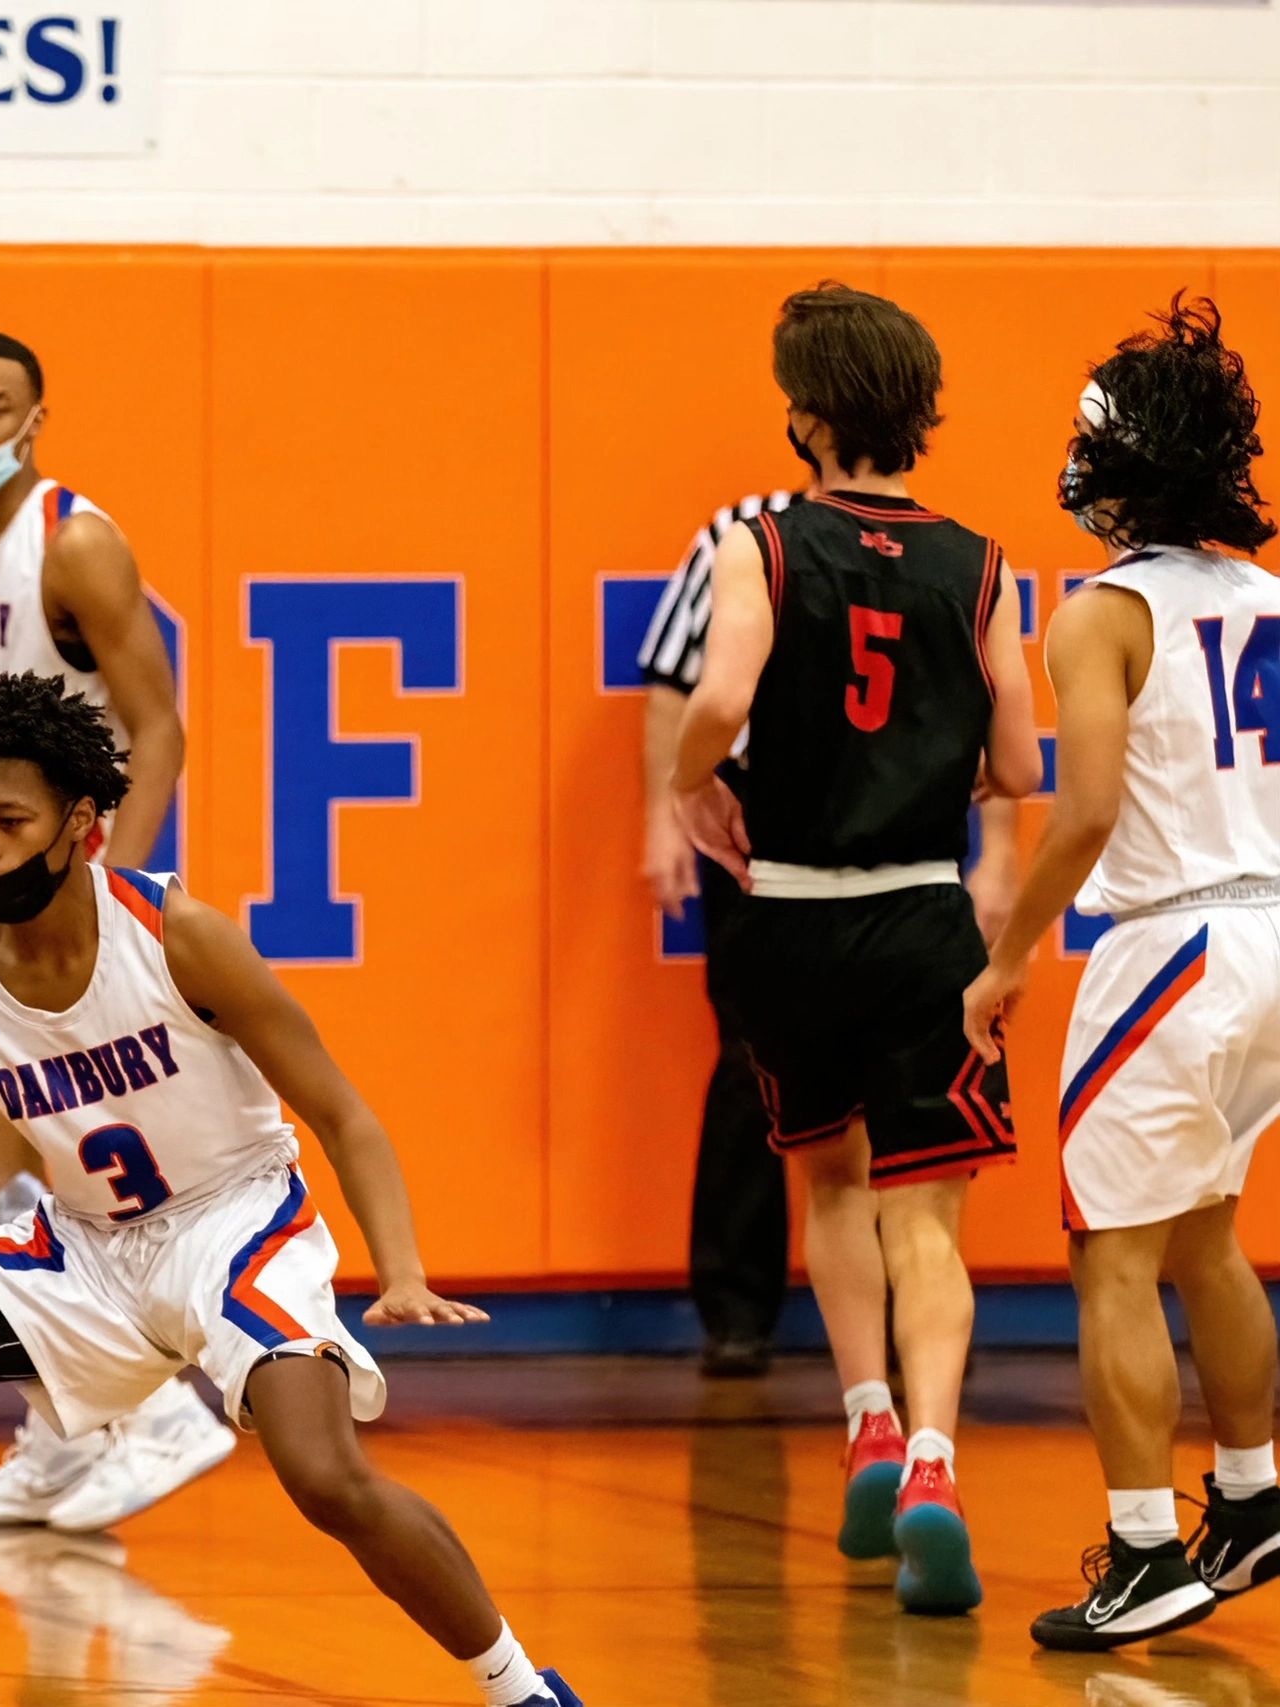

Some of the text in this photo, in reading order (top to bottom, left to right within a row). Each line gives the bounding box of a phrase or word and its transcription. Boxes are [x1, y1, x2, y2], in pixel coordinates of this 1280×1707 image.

[844, 603, 903, 732] 5
[1192, 614, 1280, 772] 14
[77, 1123, 174, 1222] 3
